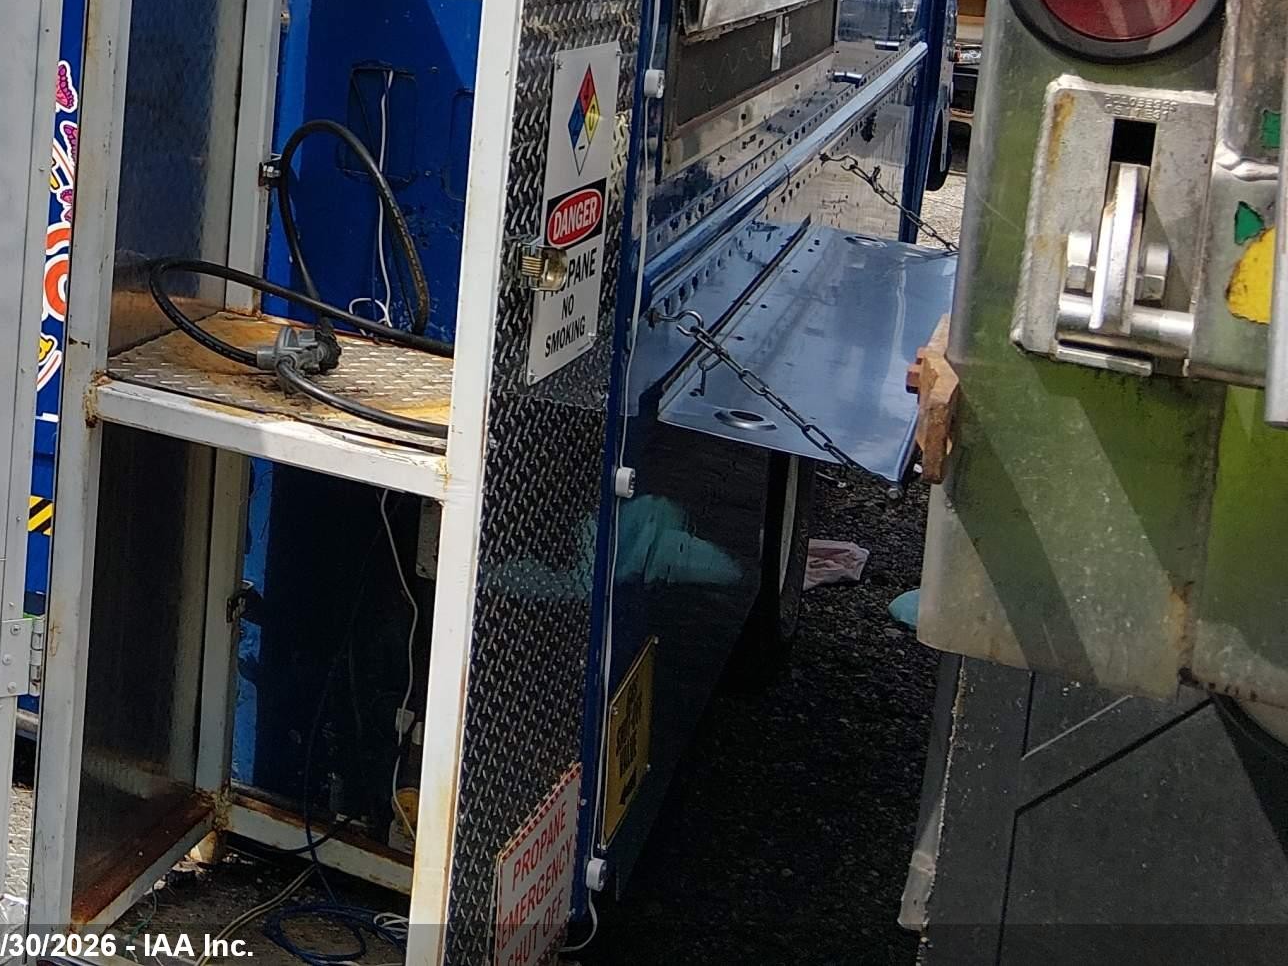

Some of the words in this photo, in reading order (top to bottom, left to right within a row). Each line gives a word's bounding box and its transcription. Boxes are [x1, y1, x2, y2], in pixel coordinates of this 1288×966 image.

[552, 196, 598, 242] DANGER
[562, 294, 575, 320] NO
[544, 315, 586, 358] SMOKING
[512, 800, 567, 891] PROPANE
[501, 833, 573, 951] EMERGENCY
[542, 887, 565, 938] OFF
